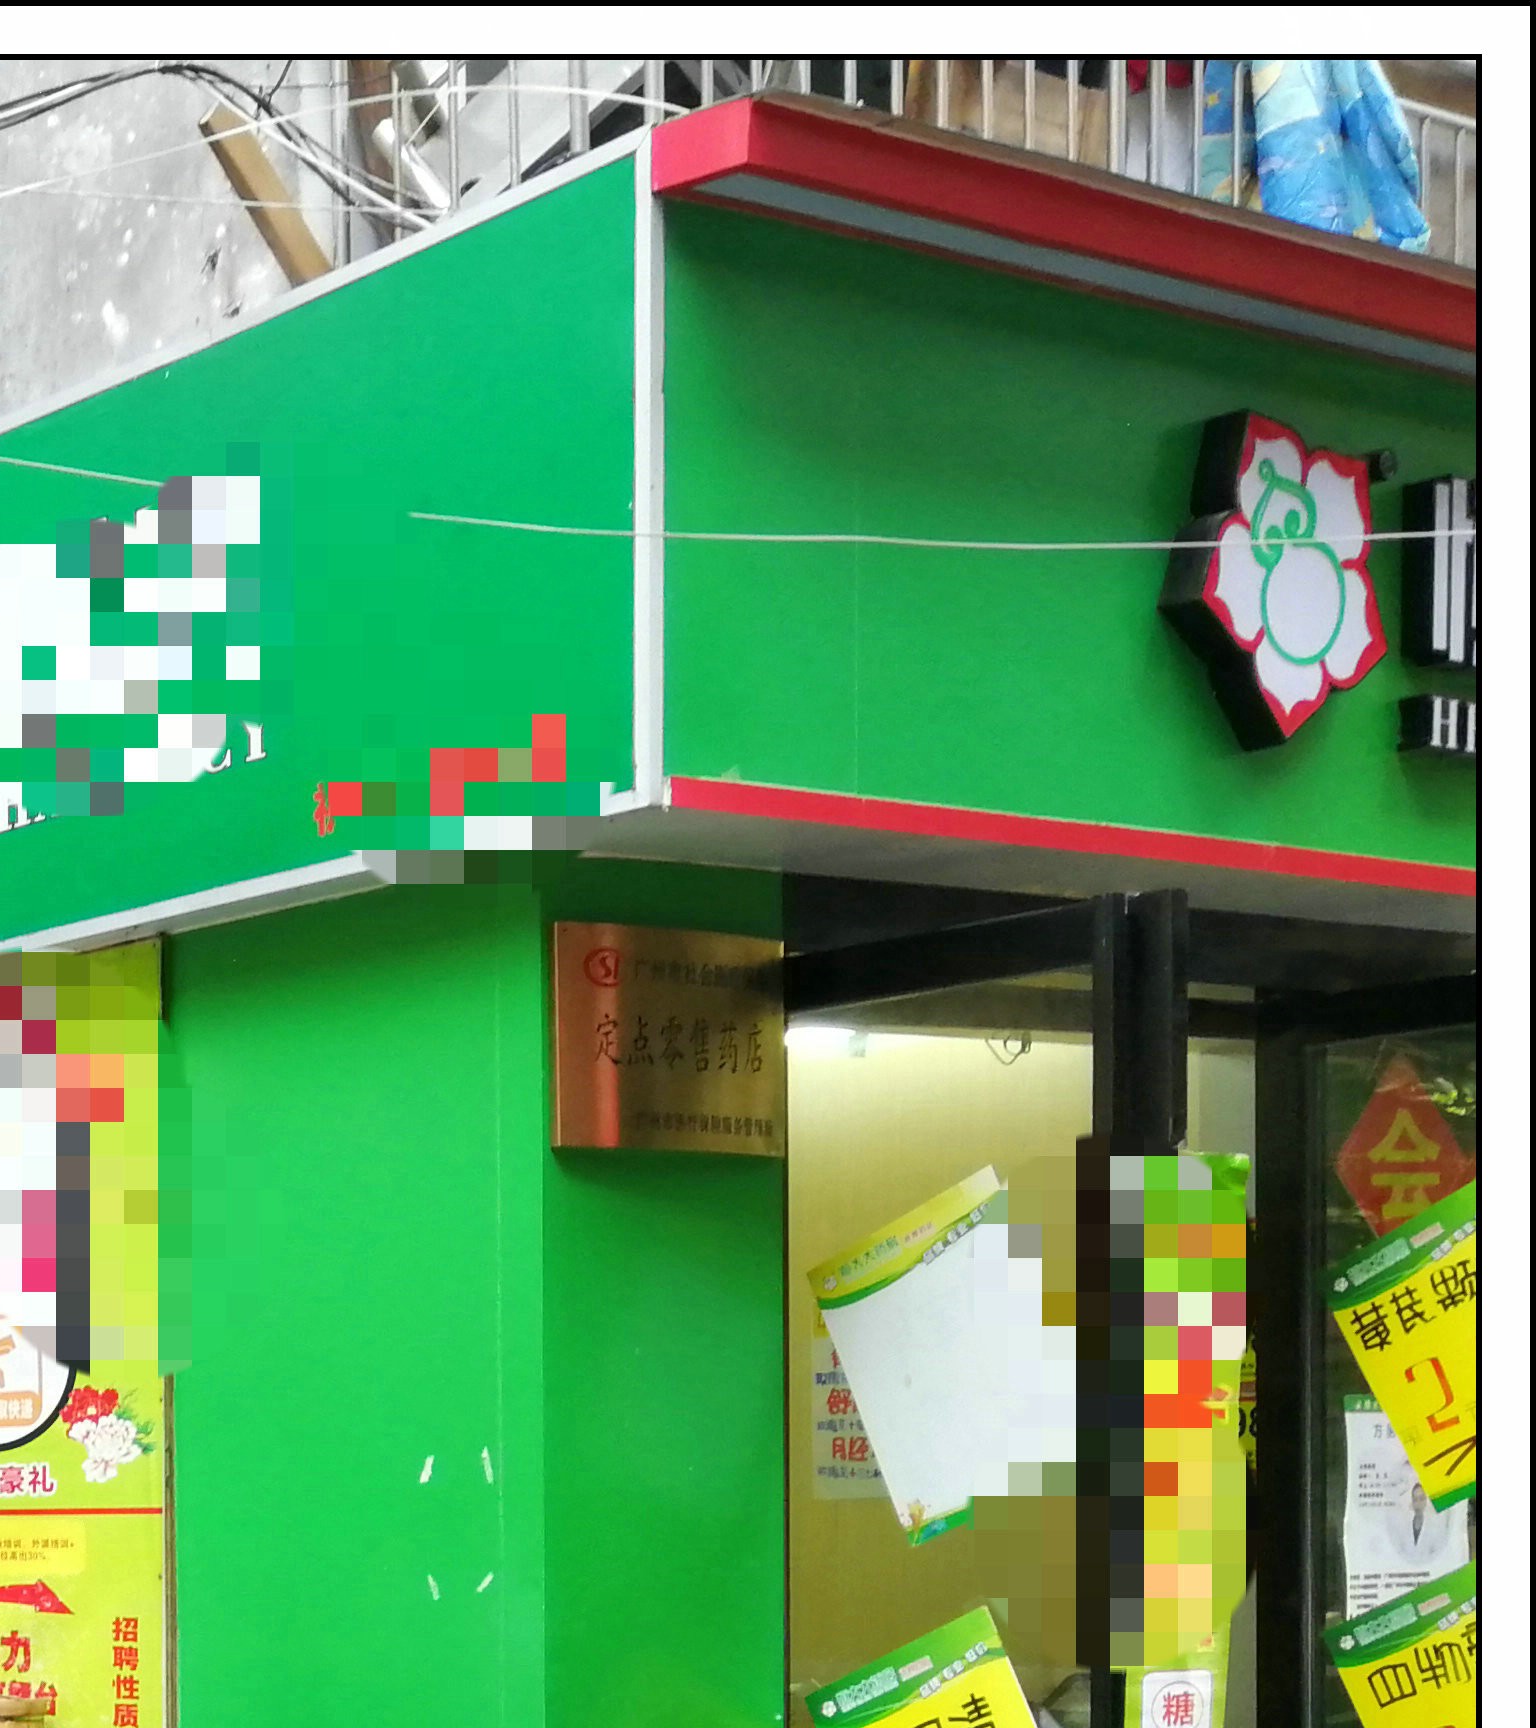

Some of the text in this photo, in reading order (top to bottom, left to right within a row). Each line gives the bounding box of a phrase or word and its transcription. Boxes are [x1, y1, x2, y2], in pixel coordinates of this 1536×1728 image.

[595, 1013, 763, 1074] 定点零售药店
[1163, 1690, 1196, 1727] 糖
